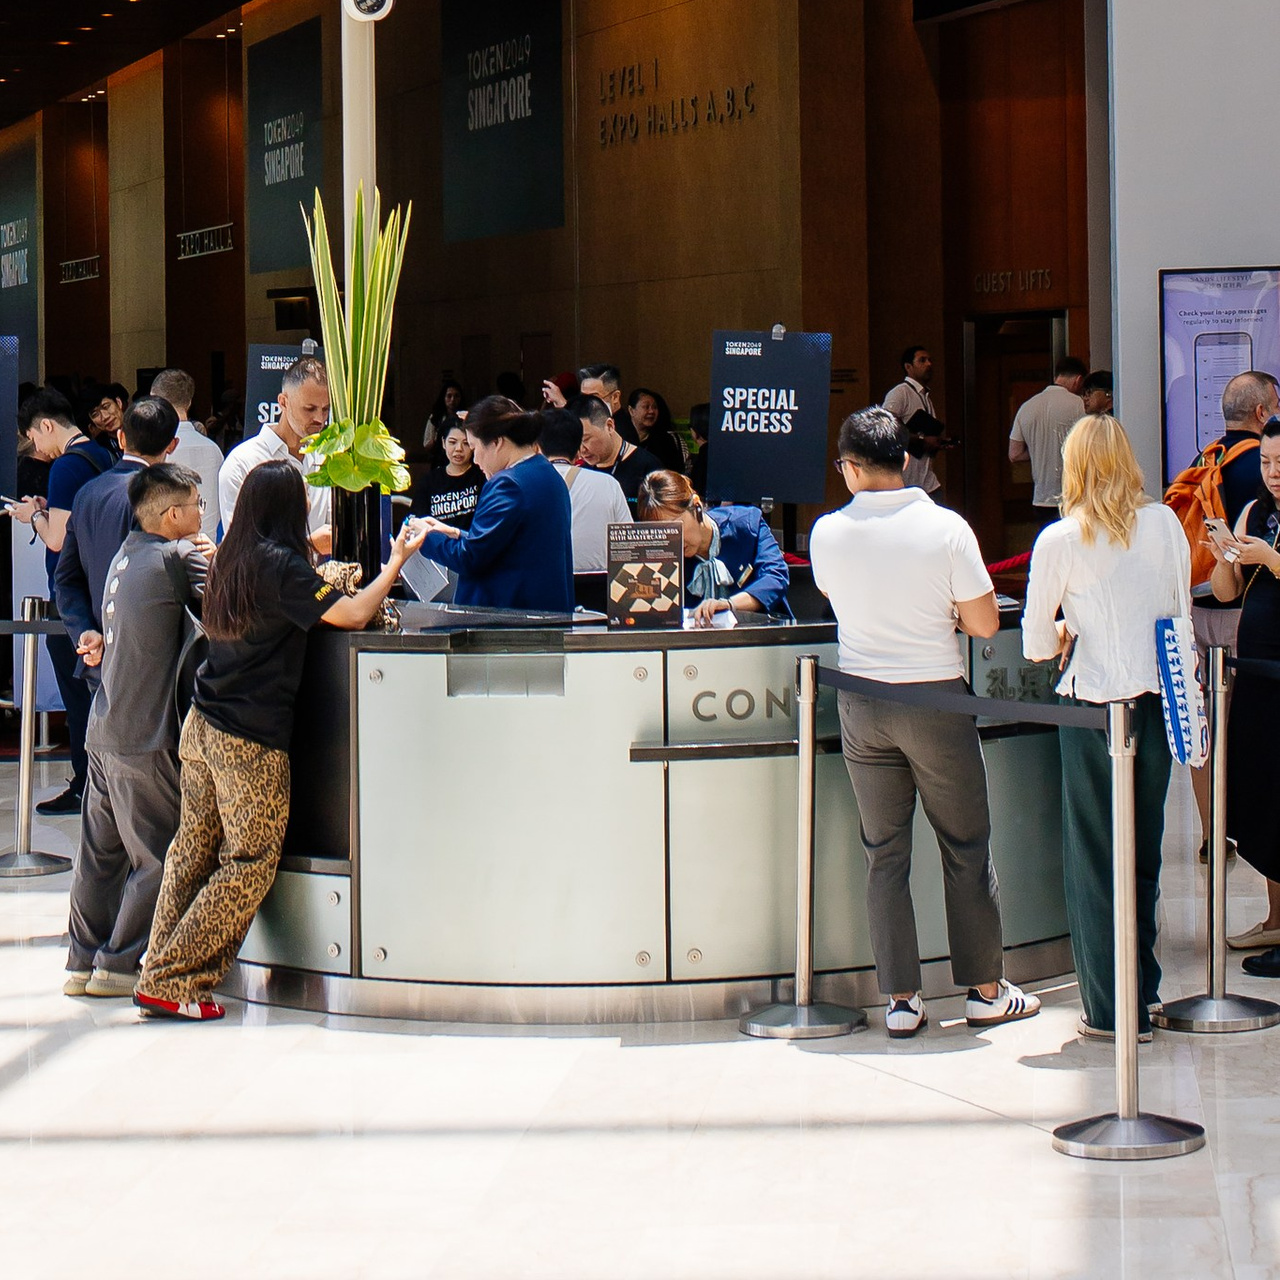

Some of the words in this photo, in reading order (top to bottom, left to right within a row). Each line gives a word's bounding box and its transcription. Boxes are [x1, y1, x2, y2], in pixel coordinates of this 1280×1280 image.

[599, 62, 644, 105] LEVEL
[468, 71, 532, 132] SINGAPORE
[599, 110, 639, 147] EXPO
[646, 94, 699, 135] HALLS
[264, 141, 305, 187] SINGAPORE
[974, 272, 1012, 293] GUEST
[1018, 269, 1052, 291] LIFTS
[725, 347, 762, 356] SINGAPORE
[722, 386, 799, 411] SPECIAL
[721, 411, 792, 434] ACCESS
